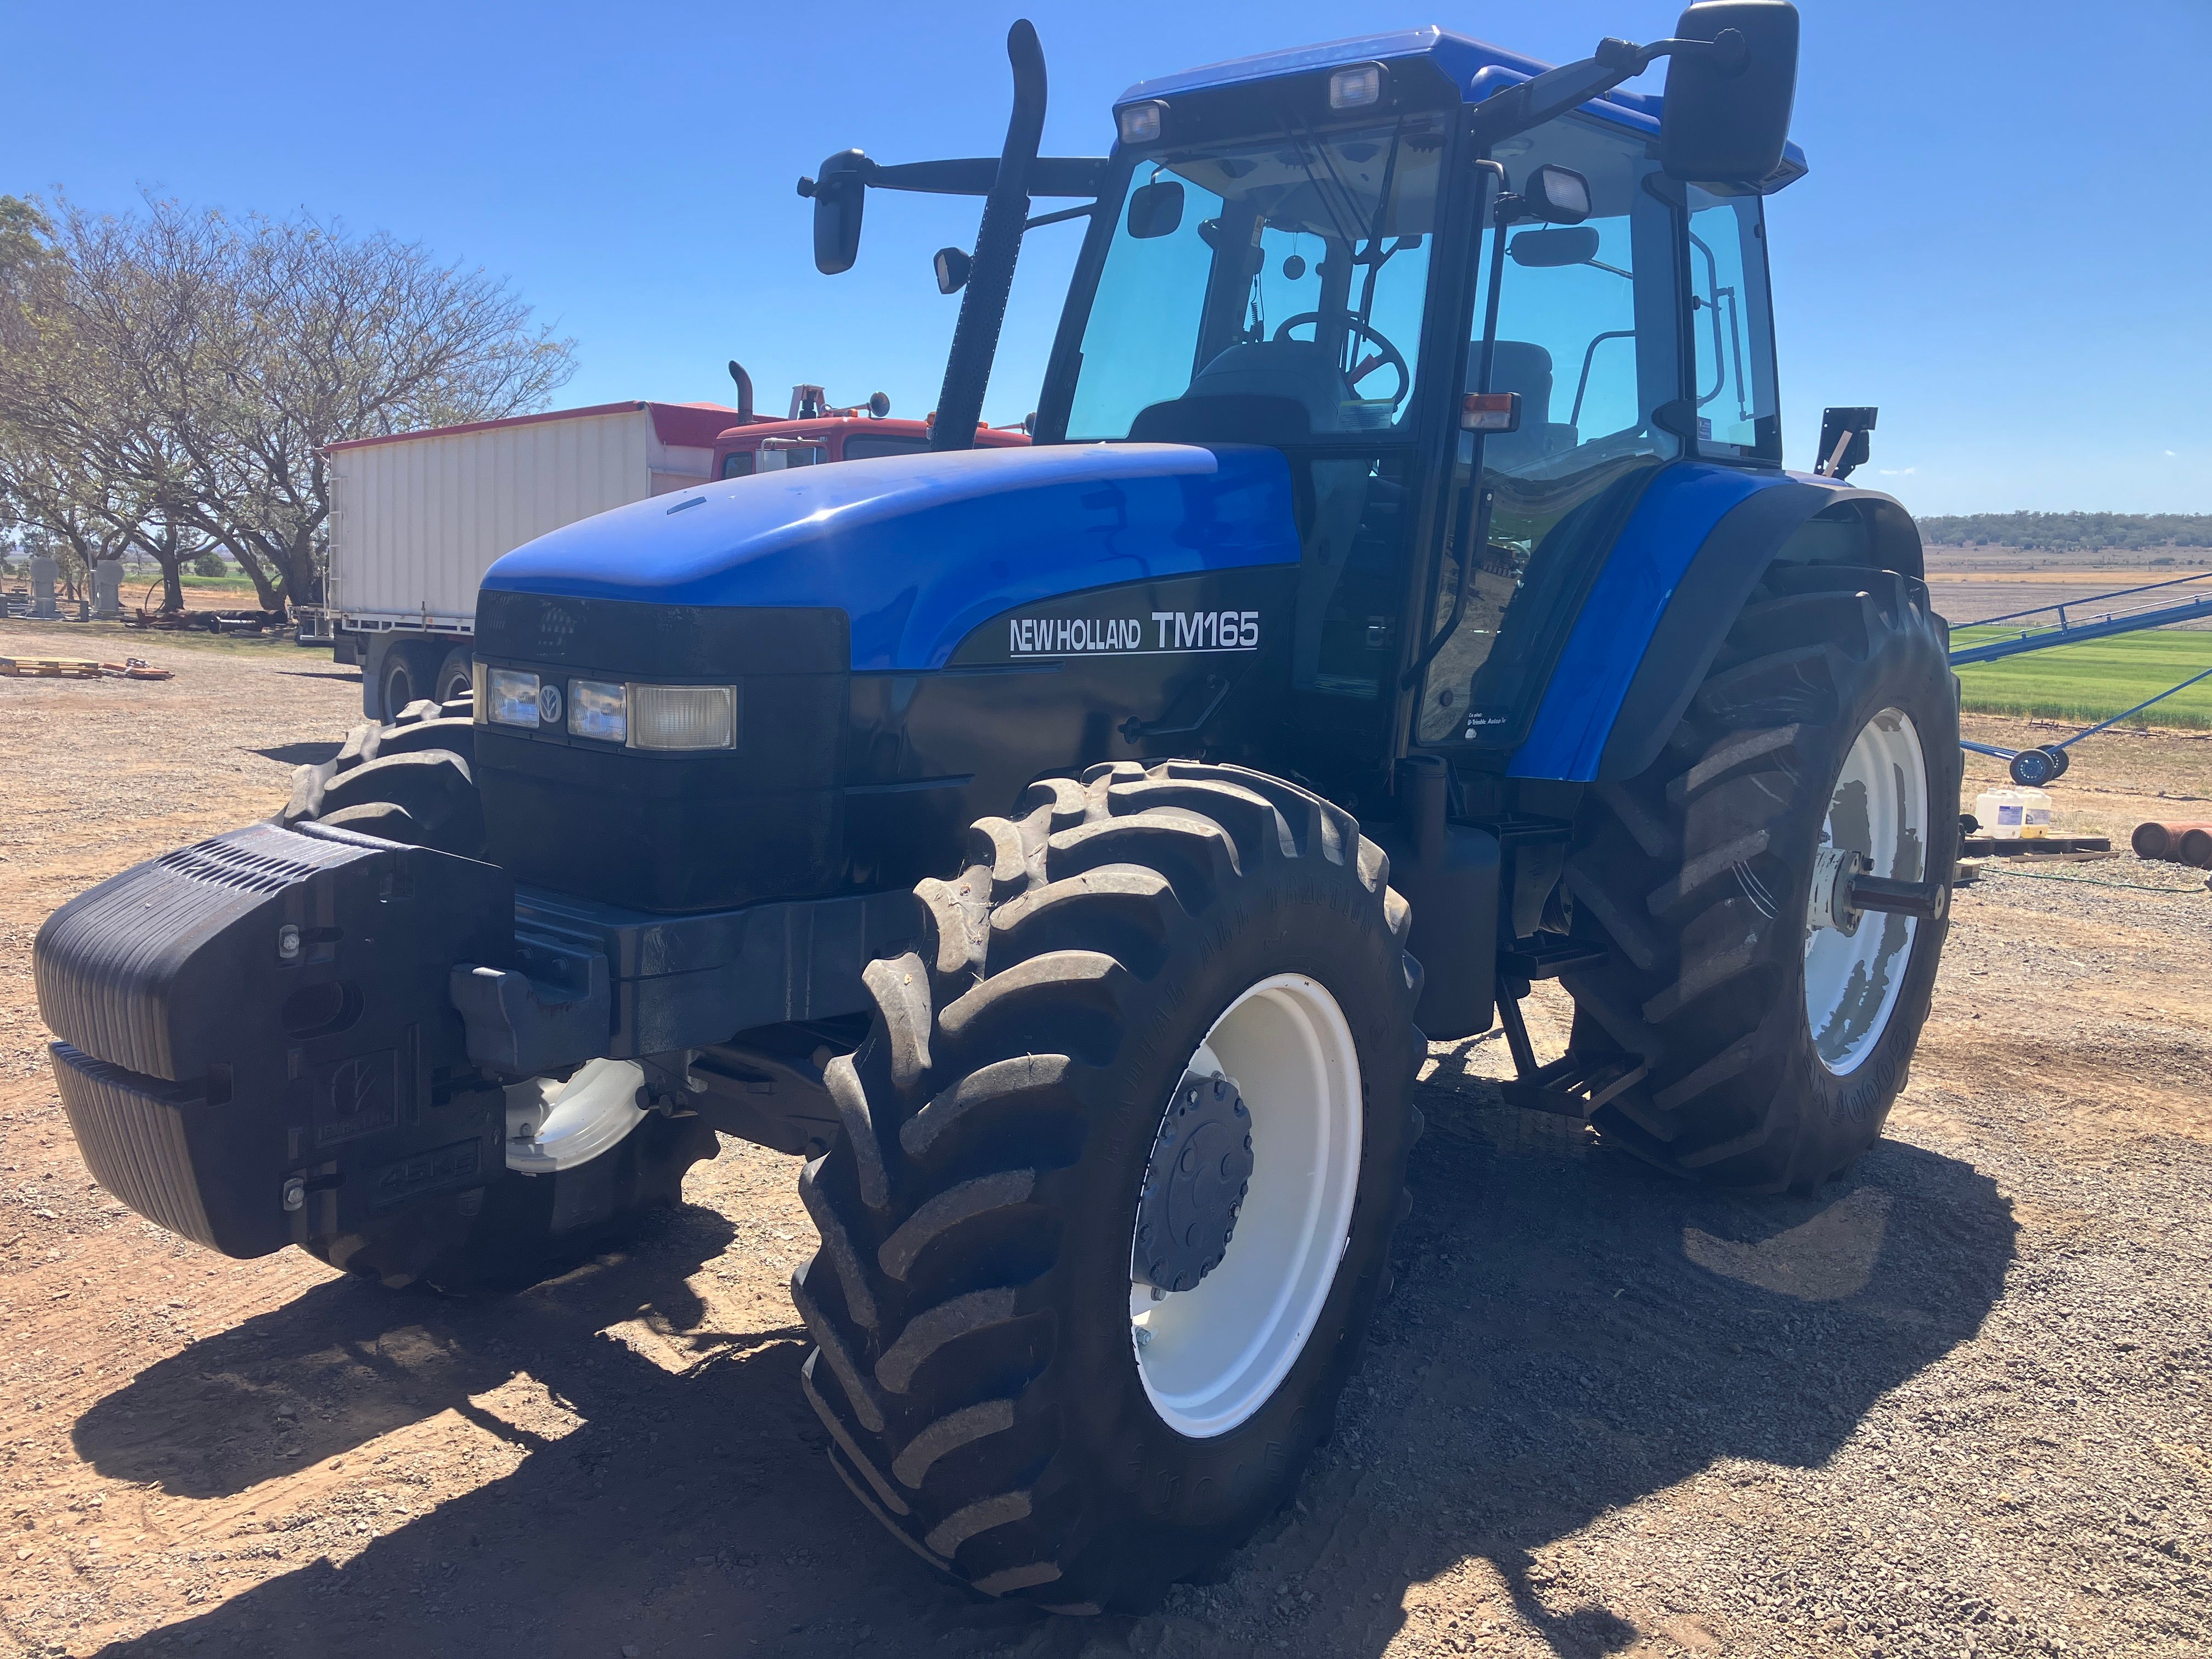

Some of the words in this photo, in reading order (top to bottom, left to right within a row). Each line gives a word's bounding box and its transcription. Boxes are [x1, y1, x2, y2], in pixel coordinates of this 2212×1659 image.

[1010, 619, 1053, 651] NEW
[1057, 618, 1141, 650] HOLLAND
[1152, 611, 1259, 648] TM165
[1266, 874, 1374, 938] TRACTION
